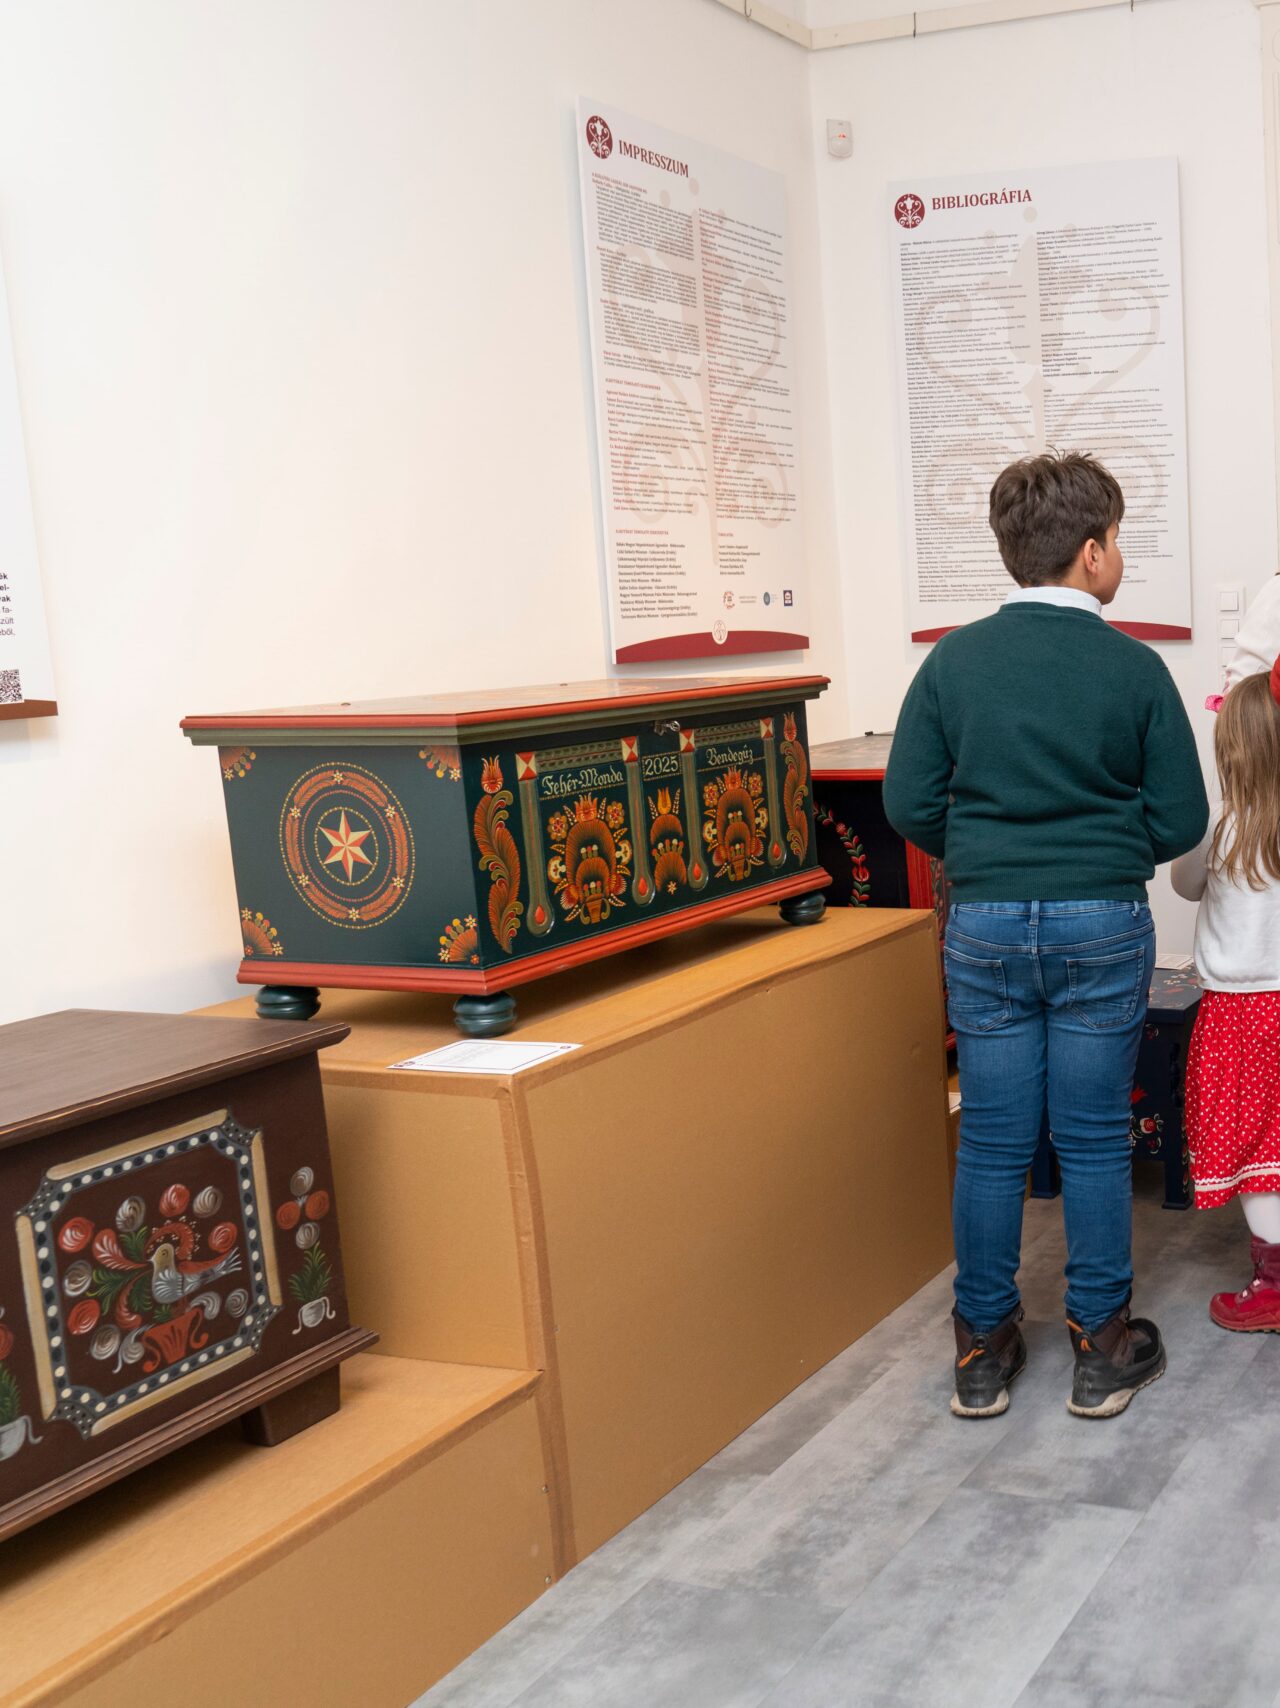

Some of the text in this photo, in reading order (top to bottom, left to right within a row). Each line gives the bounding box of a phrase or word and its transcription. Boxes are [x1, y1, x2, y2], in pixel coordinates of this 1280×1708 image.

[618, 139, 689, 178] IMPRESSZUM
[932, 187, 1032, 210] BIBLIOGRÁFIA
[645, 755, 679, 776] 2025
